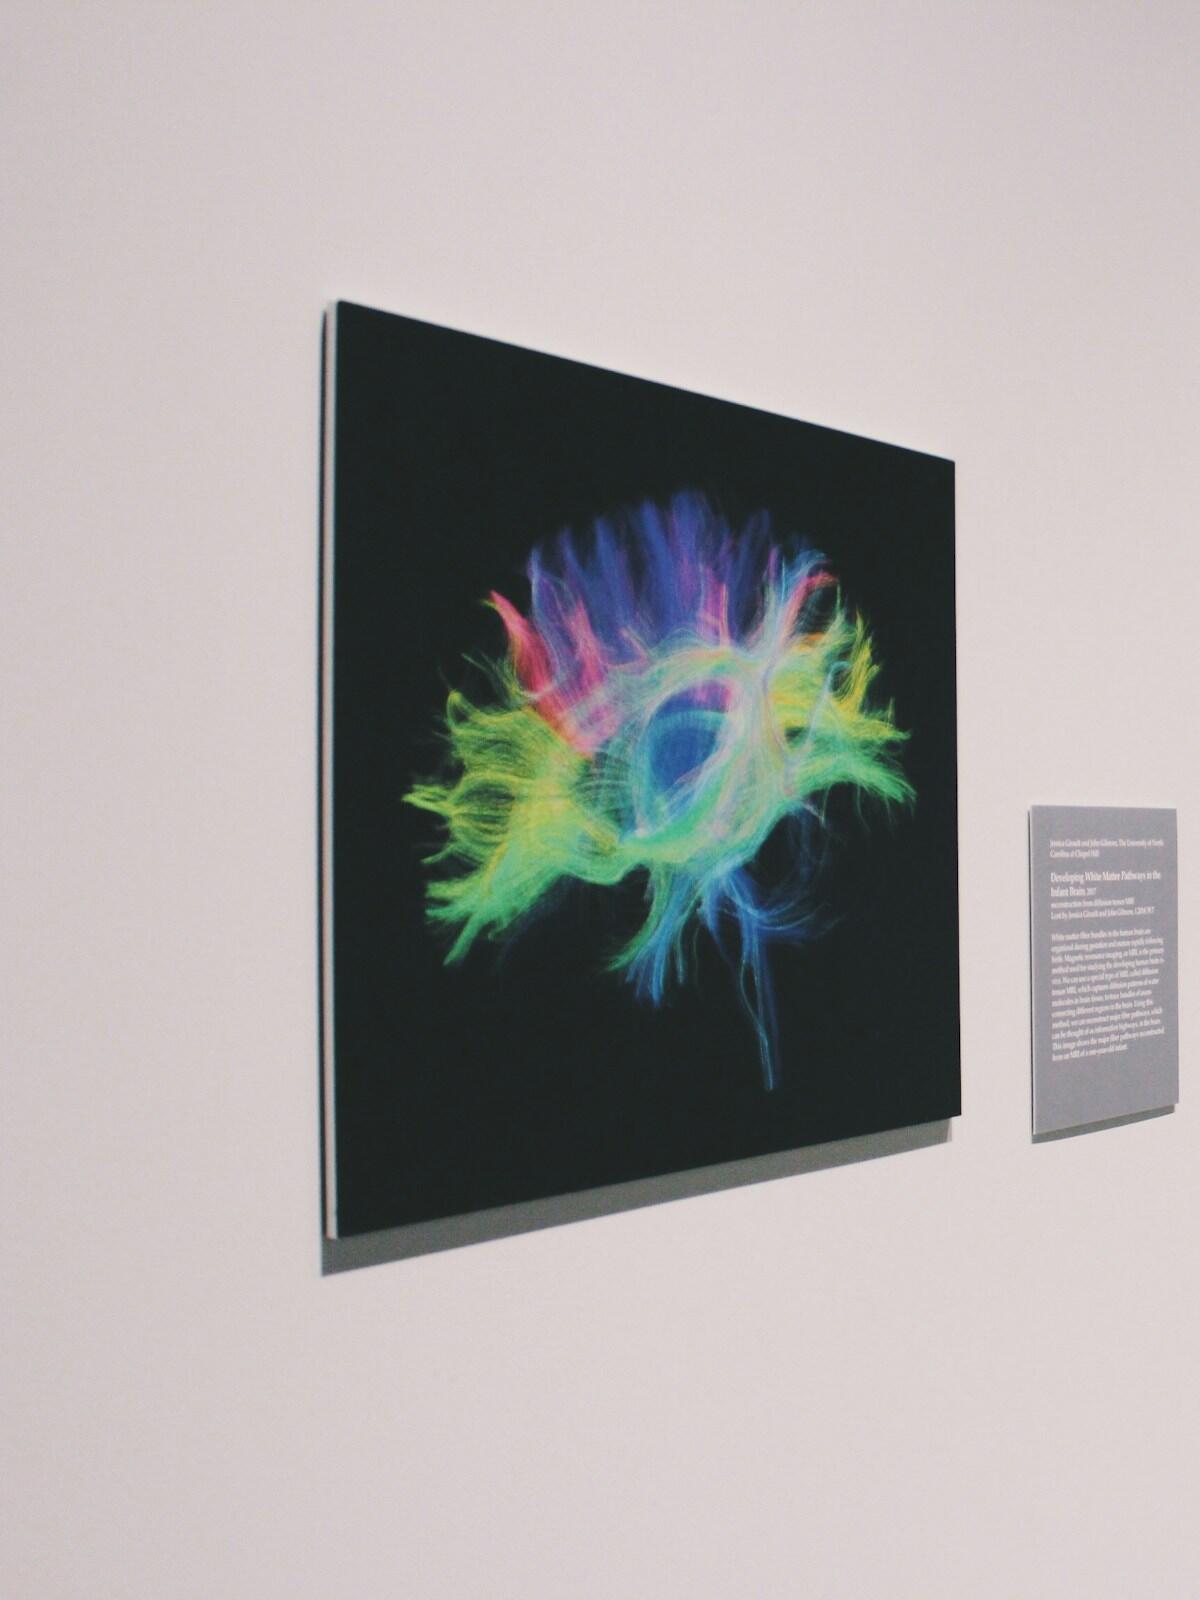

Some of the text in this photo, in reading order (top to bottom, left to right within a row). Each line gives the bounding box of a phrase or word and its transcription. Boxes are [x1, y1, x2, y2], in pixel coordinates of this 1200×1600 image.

[1127, 839, 1146, 848] University
[1075, 849, 1090, 859] Chapel
[1051, 870, 1161, 885] Developing White Matter Pathways in the
[1051, 887, 1068, 897] Infant
